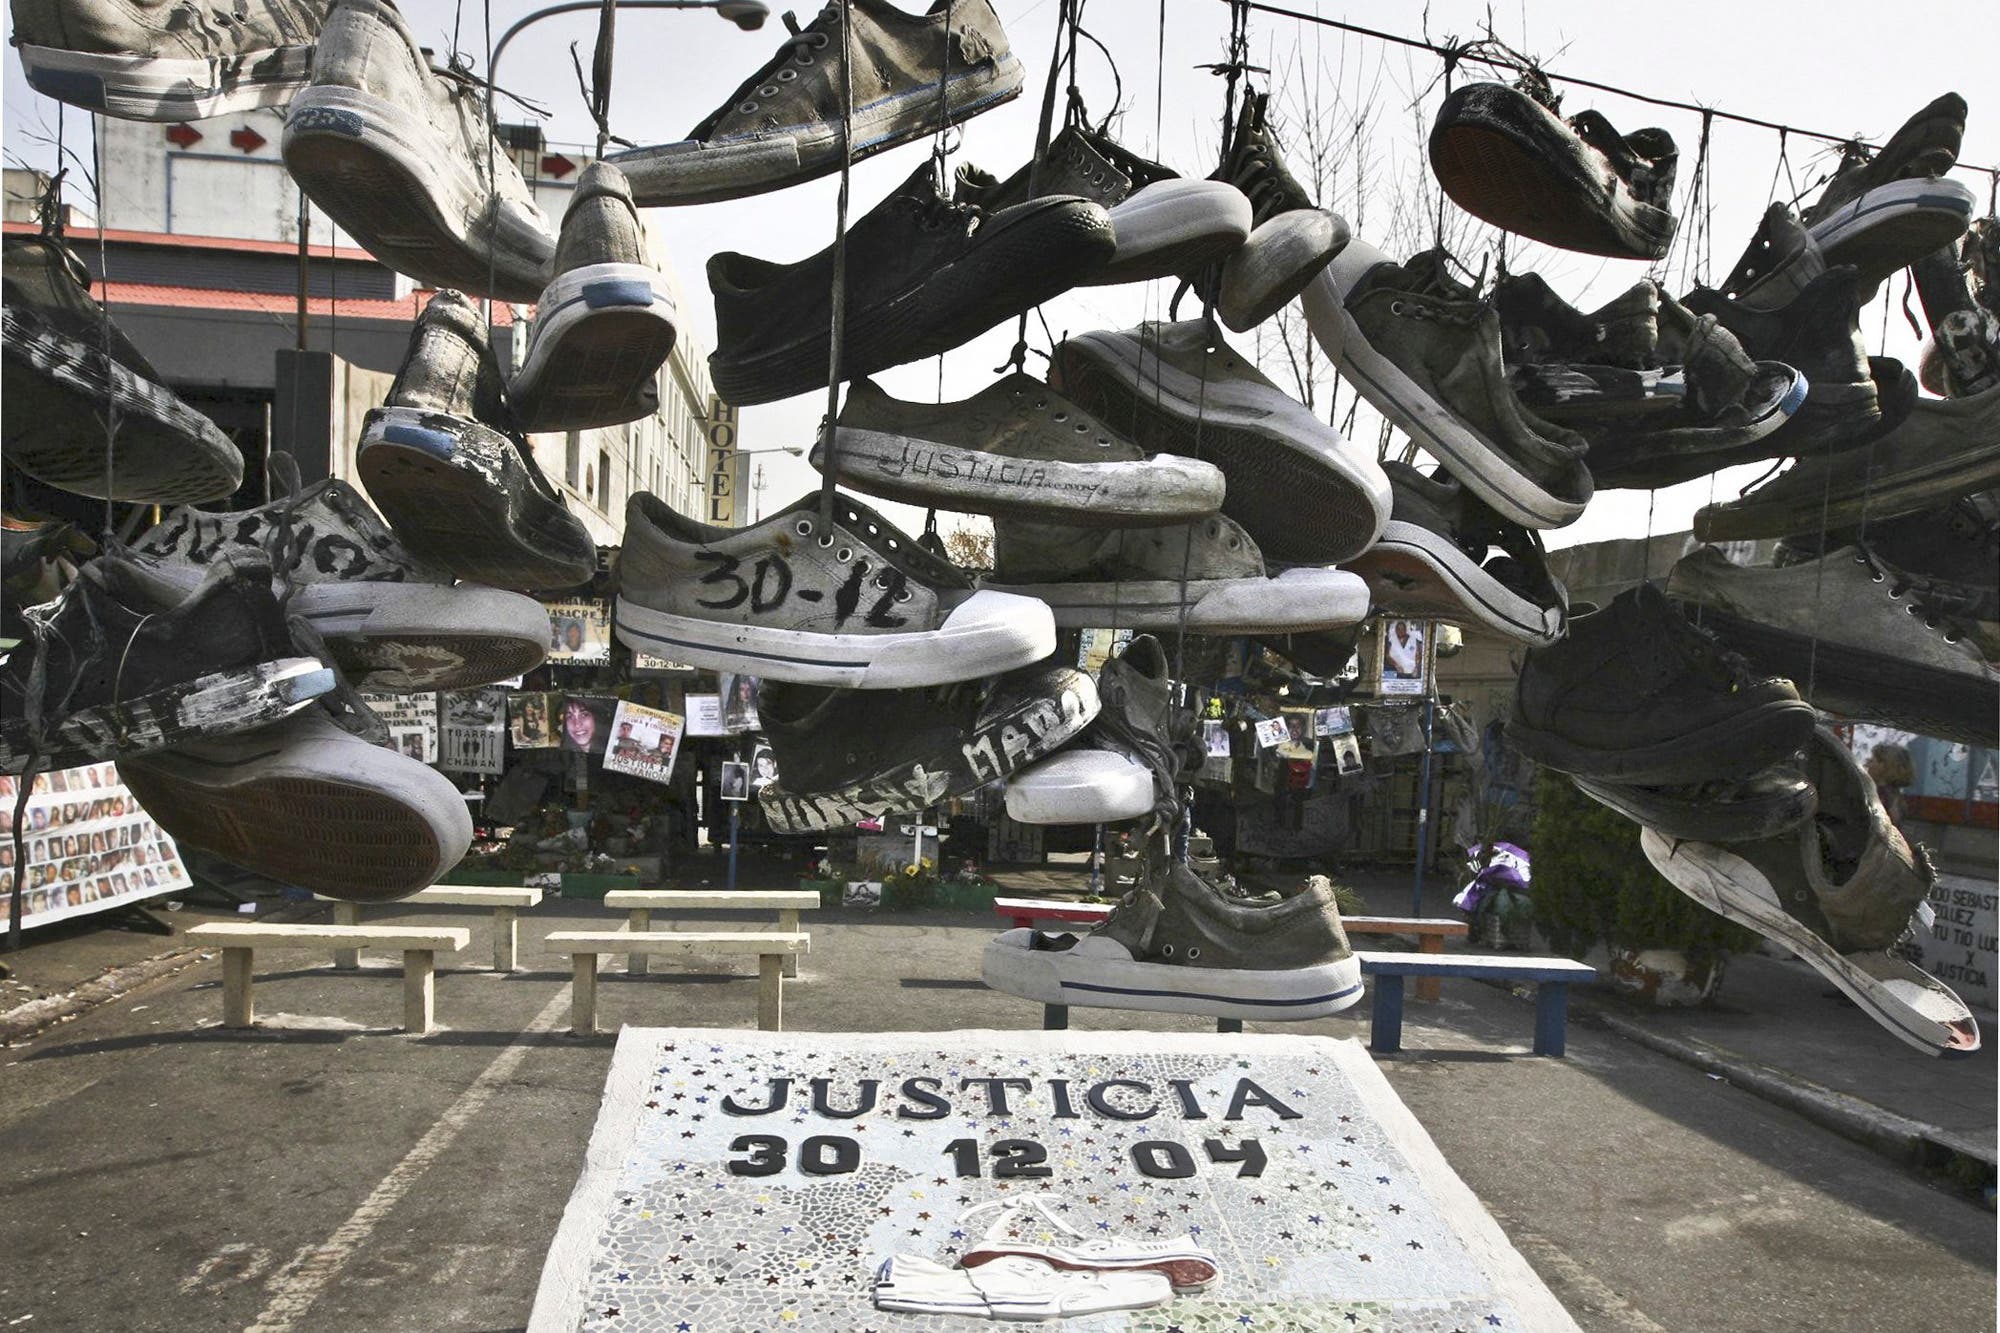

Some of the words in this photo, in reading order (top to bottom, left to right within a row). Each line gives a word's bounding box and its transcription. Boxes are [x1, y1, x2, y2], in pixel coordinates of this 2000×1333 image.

[709, 399, 735, 521] HOTEL
[877, 441, 1047, 488] JUSTICIA
[376, 709, 407, 718] ODOS
[447, 758, 496, 768] CHABAN
[1933, 924, 1948, 942] TU
[1954, 929, 1974, 947] TIO
[1966, 950, 1975, 967] X
[721, 1076, 1304, 1121] JUSTICIA
[727, 1134, 861, 1179] 30
[942, 1138, 1053, 1179] 12
[1130, 1138, 1269, 1179] 04
